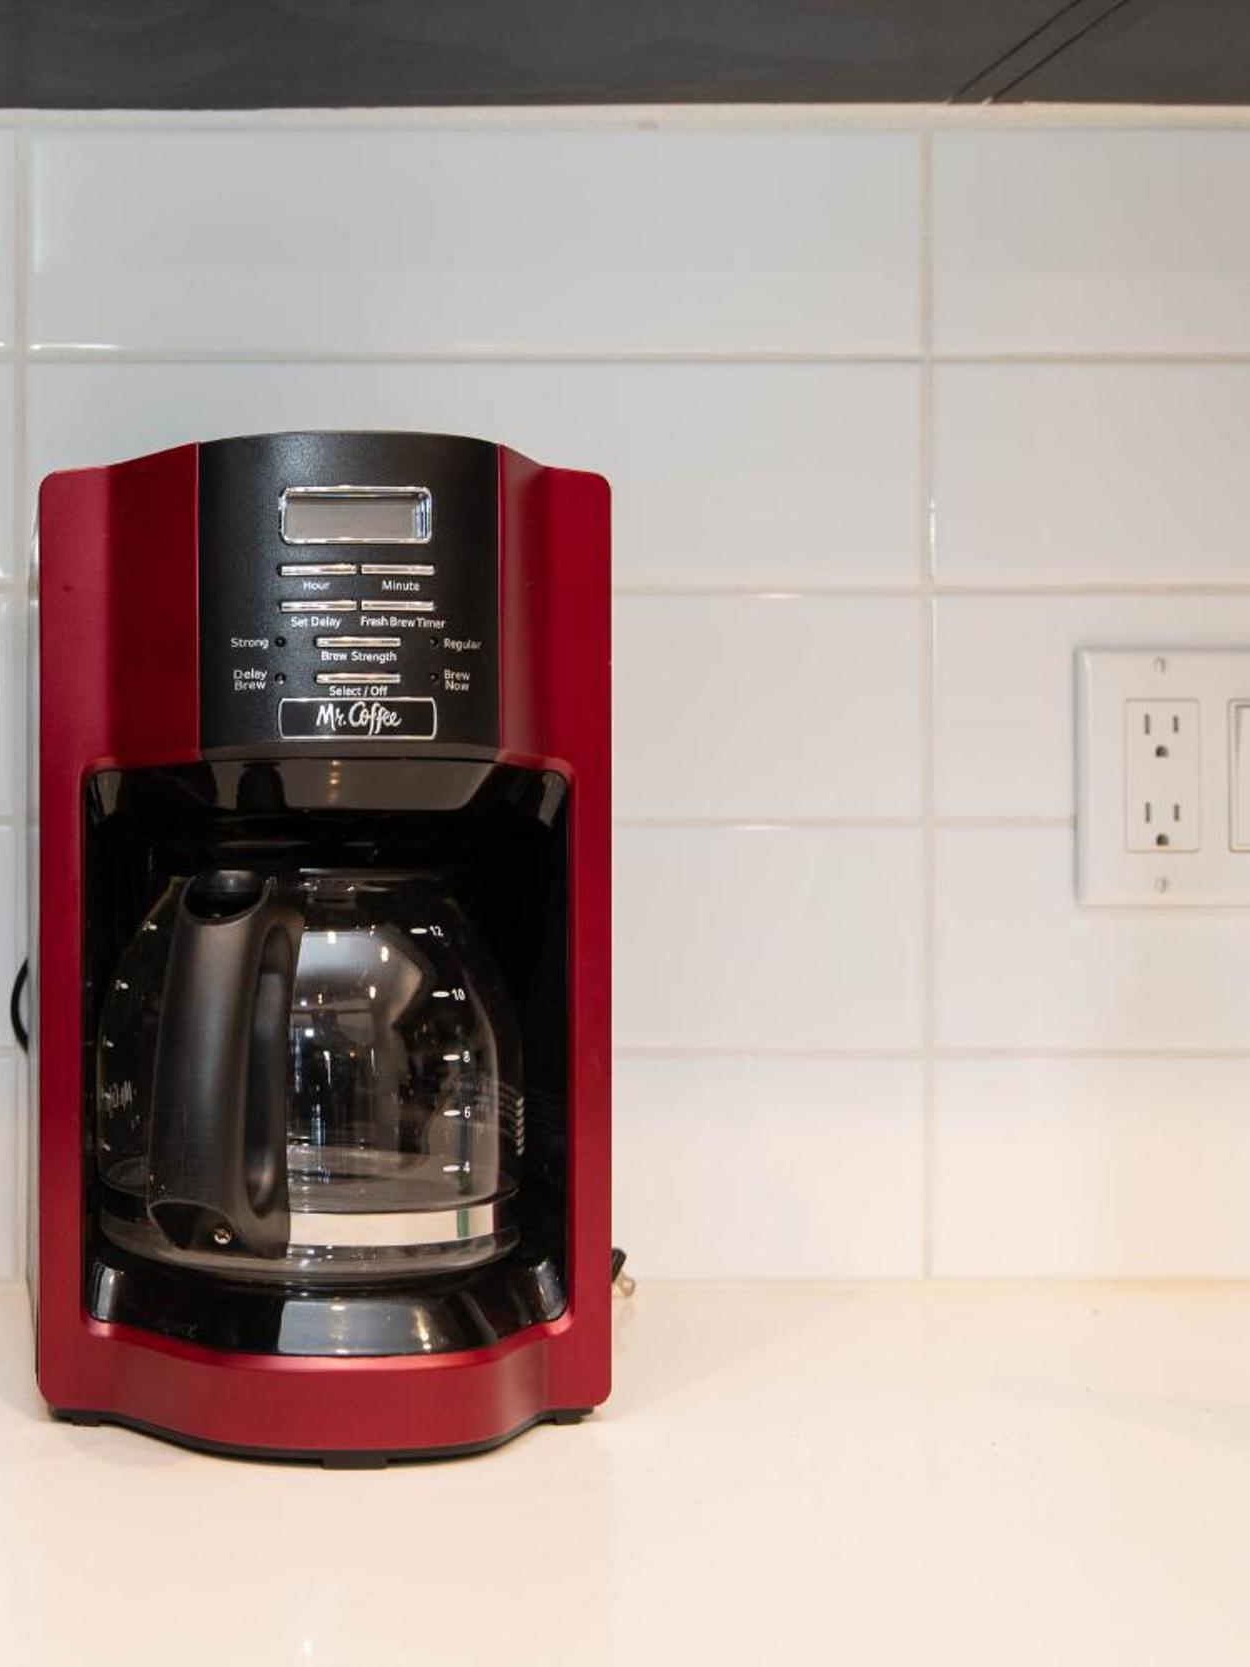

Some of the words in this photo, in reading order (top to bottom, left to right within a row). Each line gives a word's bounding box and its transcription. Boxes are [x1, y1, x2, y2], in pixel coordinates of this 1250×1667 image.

[303, 581, 330, 591] Hour
[382, 580, 420, 591] Minute
[311, 616, 342, 629] Delay
[361, 616, 388, 627] Fresh
[390, 617, 415, 628] Brew
[417, 617, 445, 629] Timer
[231, 637, 269, 649] Strong
[444, 638, 482, 652] Regular
[321, 651, 347, 661] Brew
[351, 651, 397, 664] Strength
[233, 668, 267, 680] Delay
[444, 669, 470, 680] Brew
[235, 681, 266, 691] Brew
[329, 686, 361, 697] Select
[370, 685, 388, 697] Off
[445, 680, 469, 691] Now
[316, 702, 346, 731] Mr.
[349, 701, 402, 736] Coffee
[430, 926, 444, 937] 12
[451, 988, 466, 1001] 10
